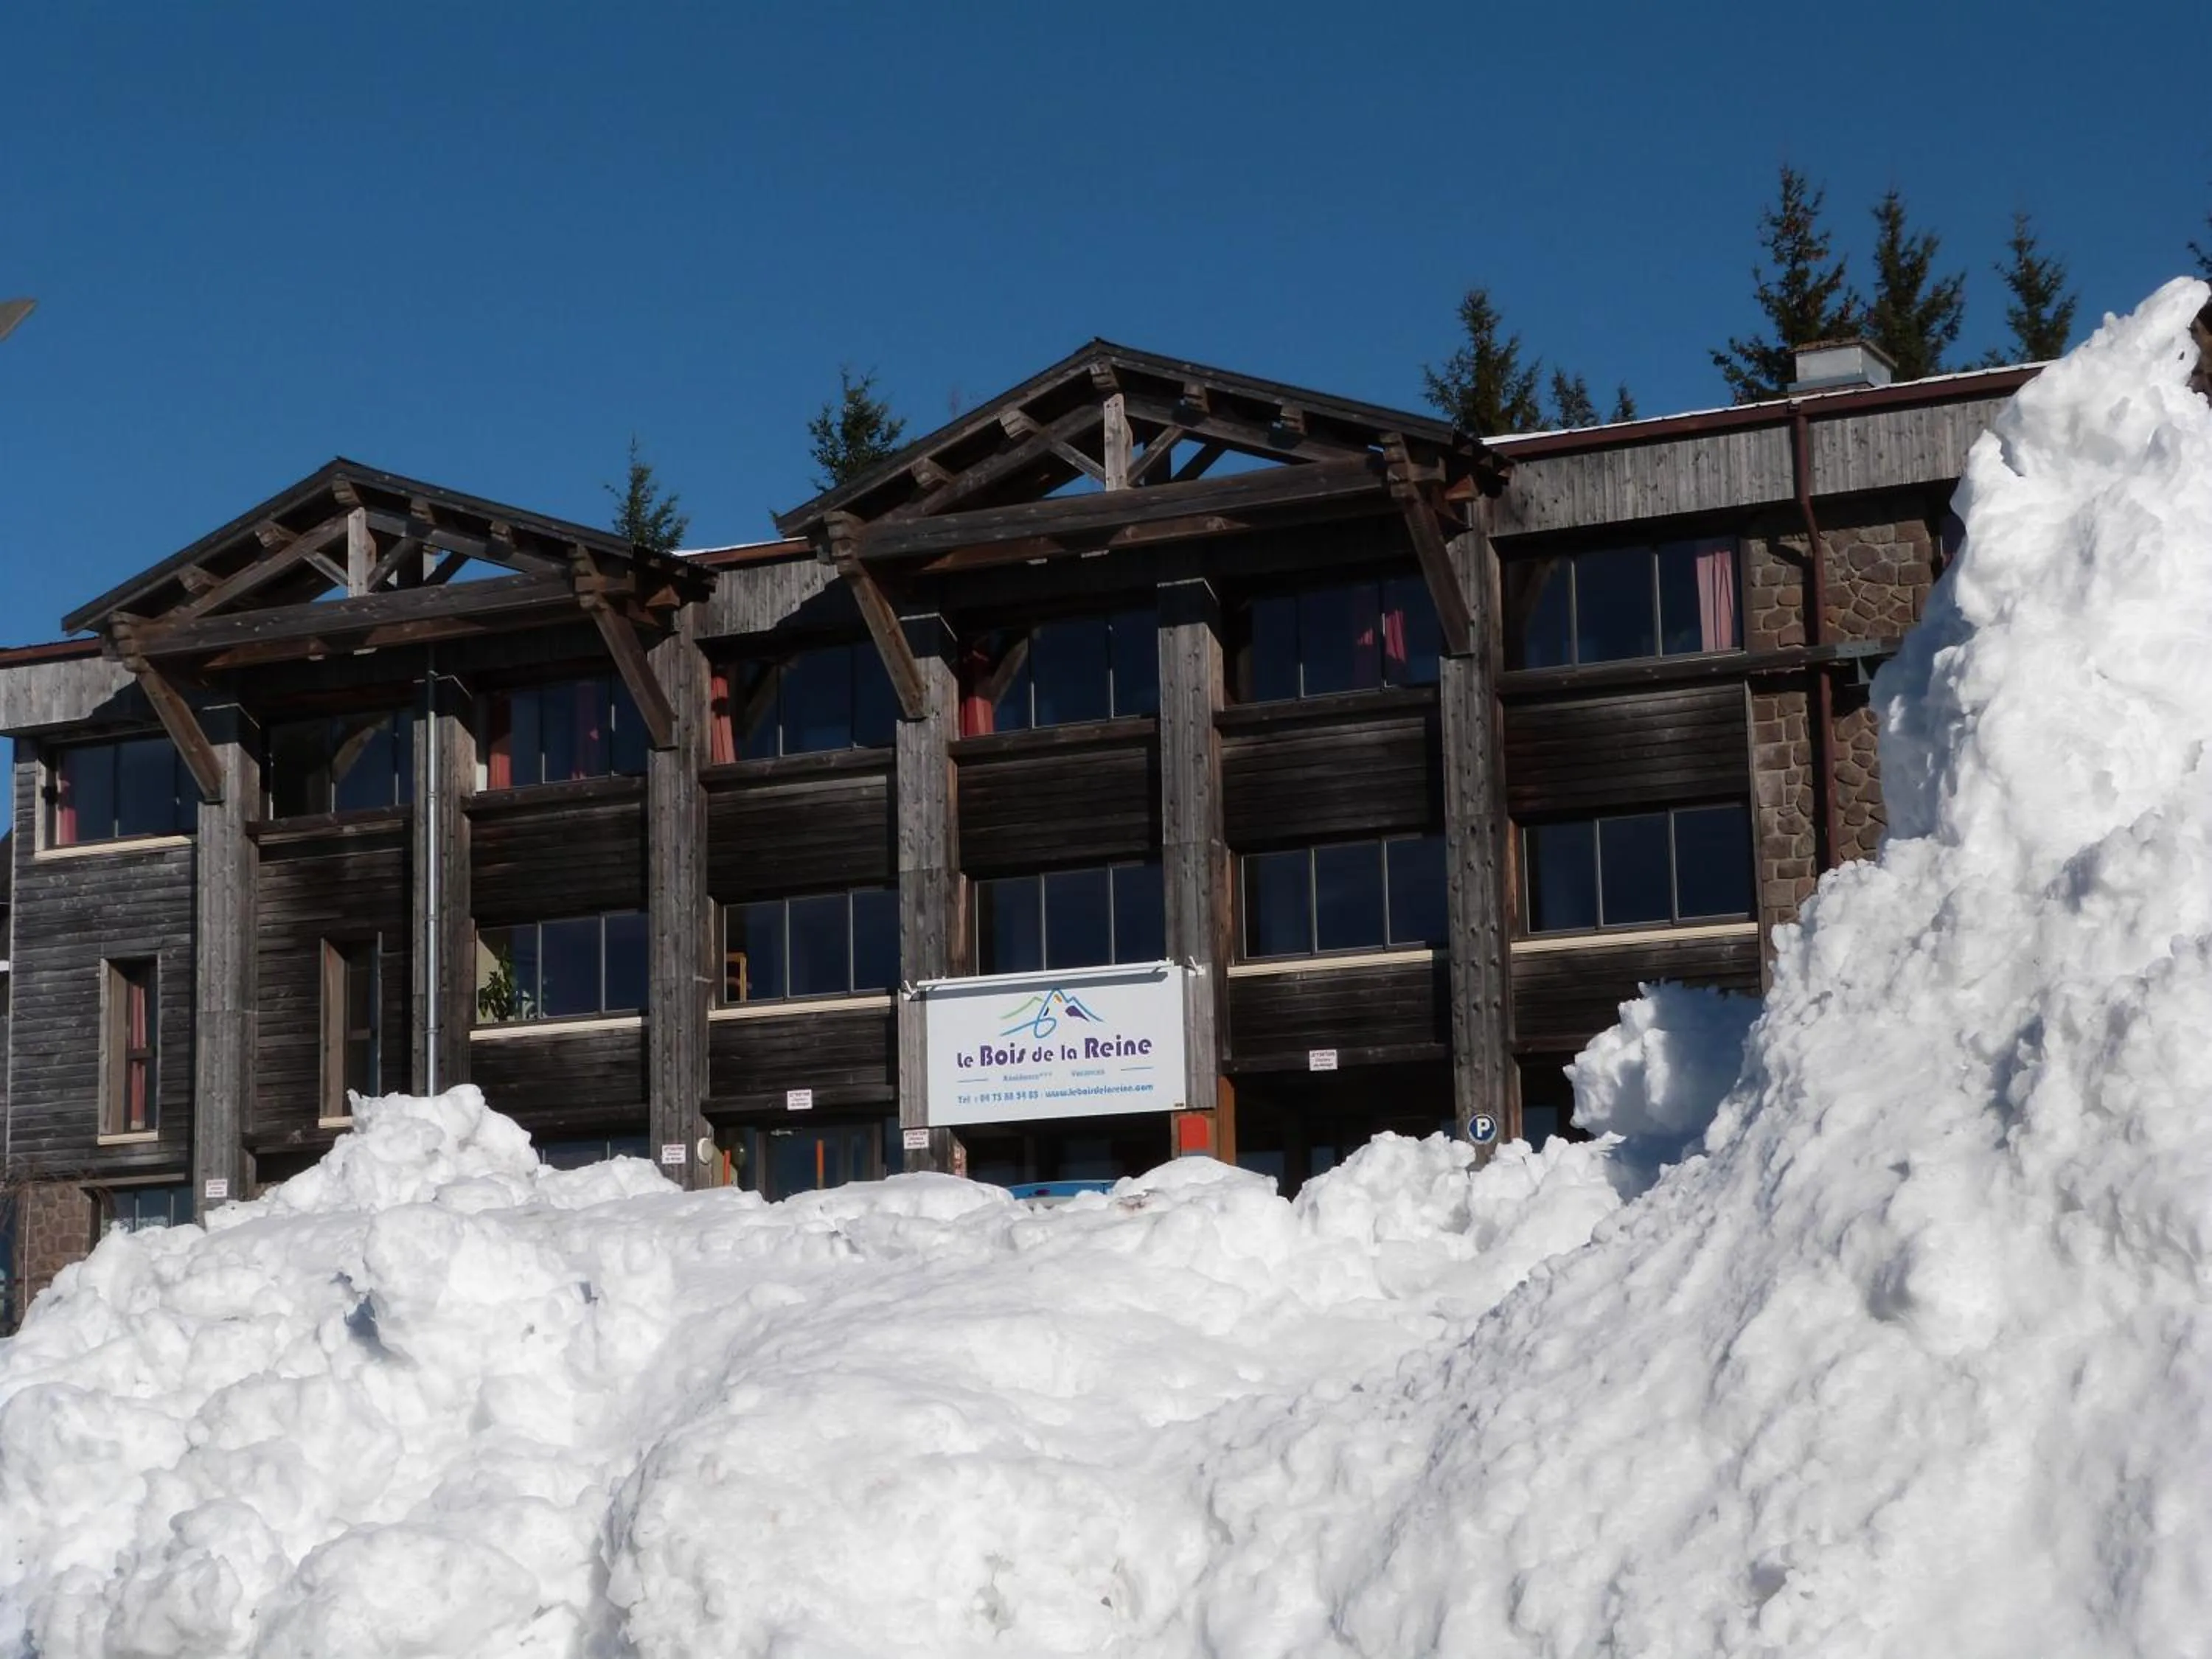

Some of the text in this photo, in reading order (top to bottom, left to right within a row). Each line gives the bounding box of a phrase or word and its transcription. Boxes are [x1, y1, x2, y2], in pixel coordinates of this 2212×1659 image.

[979, 1042, 1026, 1066] Bois
[1032, 1046, 1054, 1062] de
[1061, 1044, 1077, 1060] la
[1084, 1034, 1152, 1059] Reine
[1477, 1118, 1490, 1138] P
